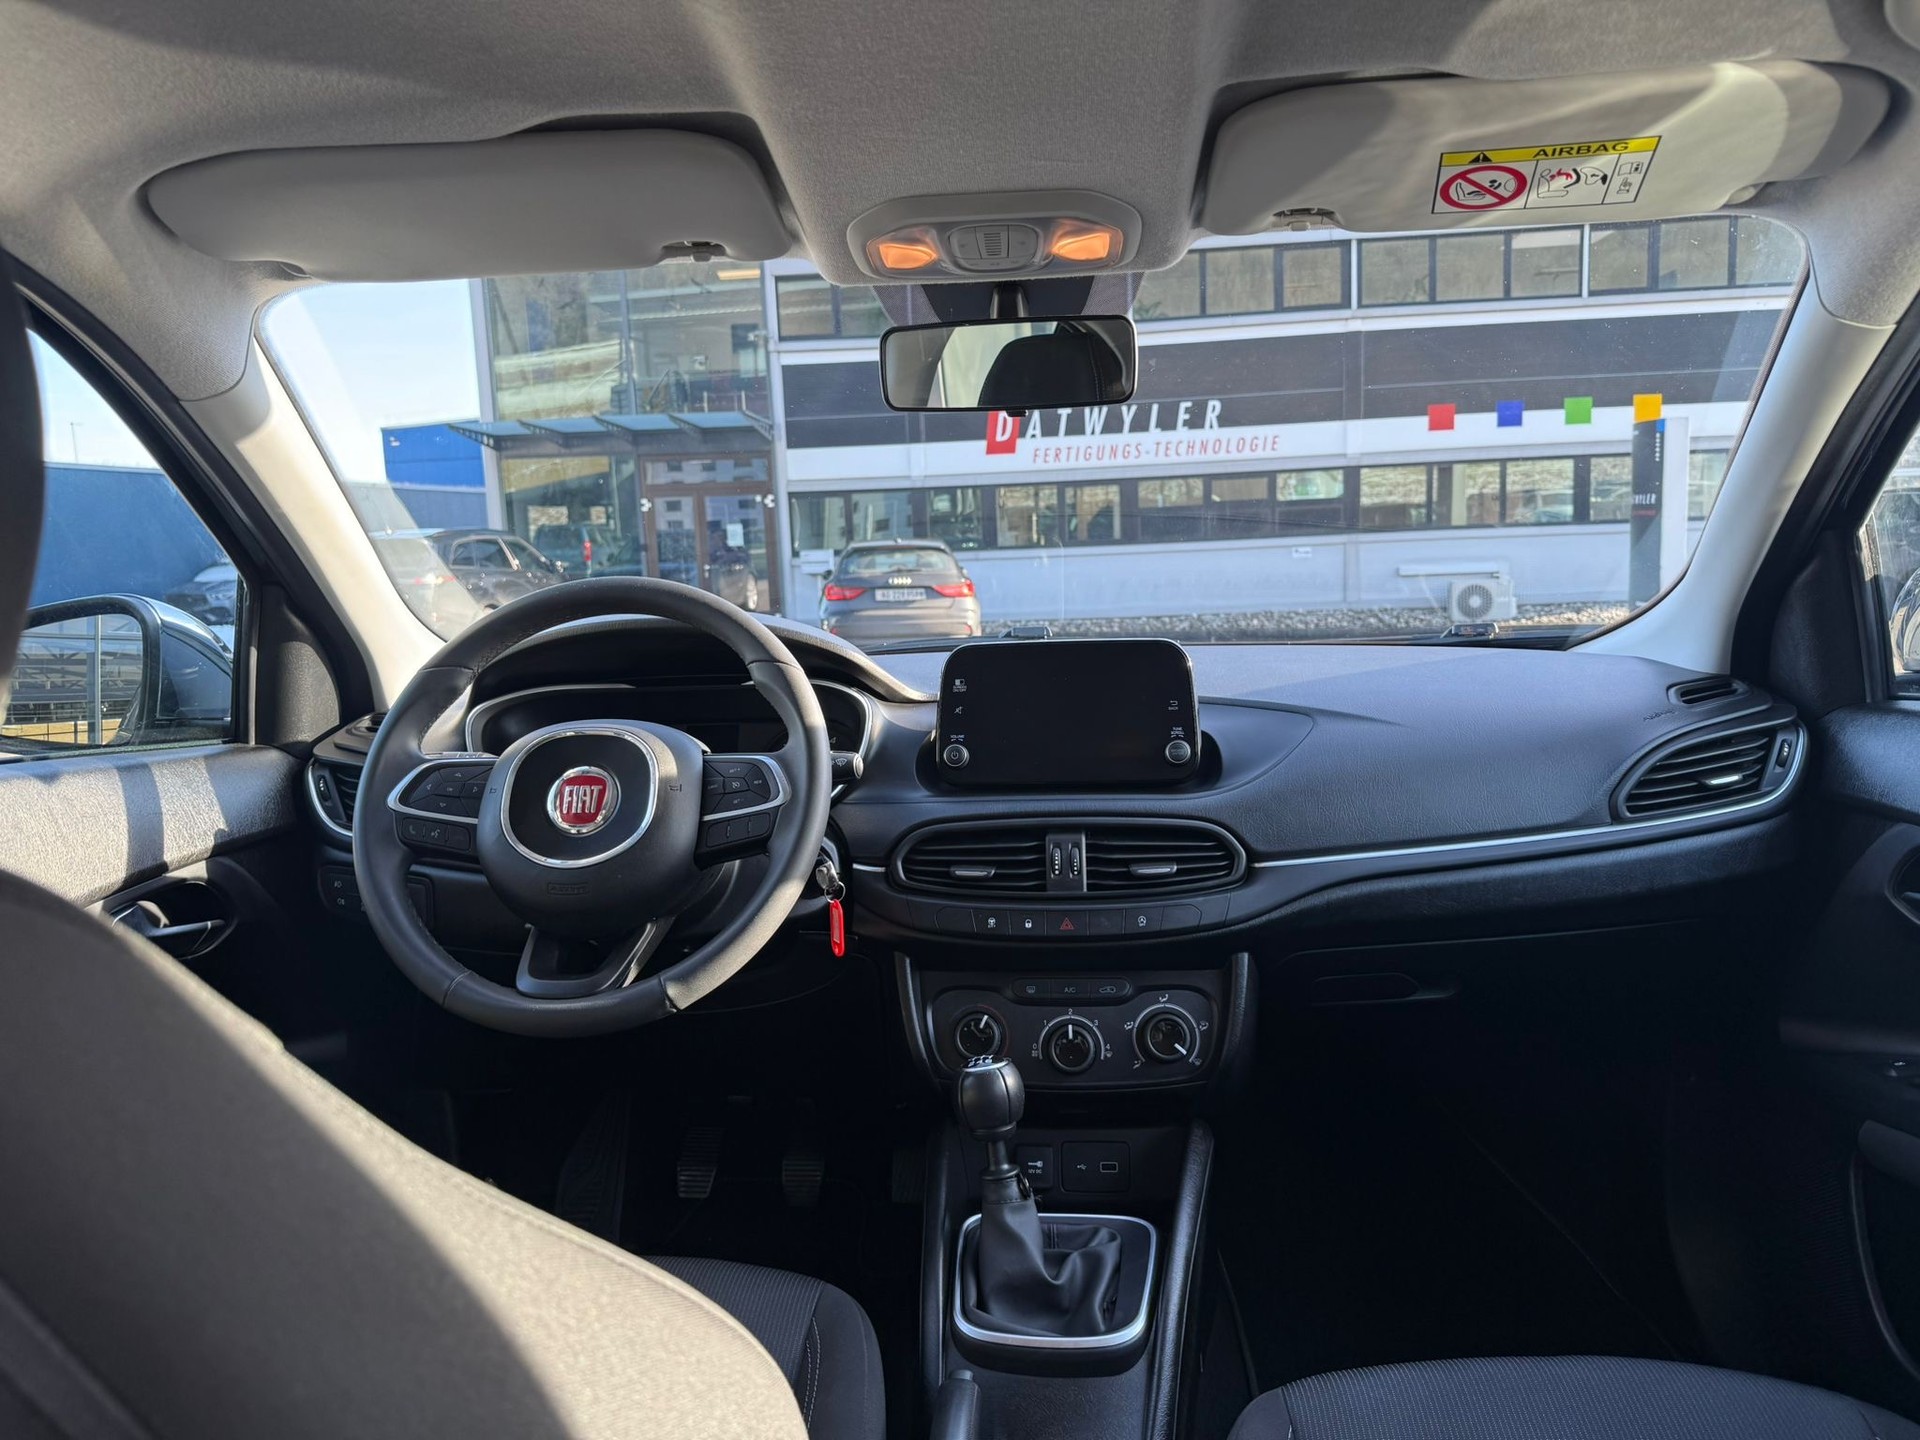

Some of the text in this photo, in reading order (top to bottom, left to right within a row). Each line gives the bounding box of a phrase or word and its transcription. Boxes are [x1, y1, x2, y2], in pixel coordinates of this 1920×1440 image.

[1532, 141, 1630, 159] AIRBAG
[995, 398, 1224, 443] DATWYLER
[1032, 434, 1281, 464] FERTIGUNGS-TECHNOLOGIE
[562, 785, 603, 814] FIAT
